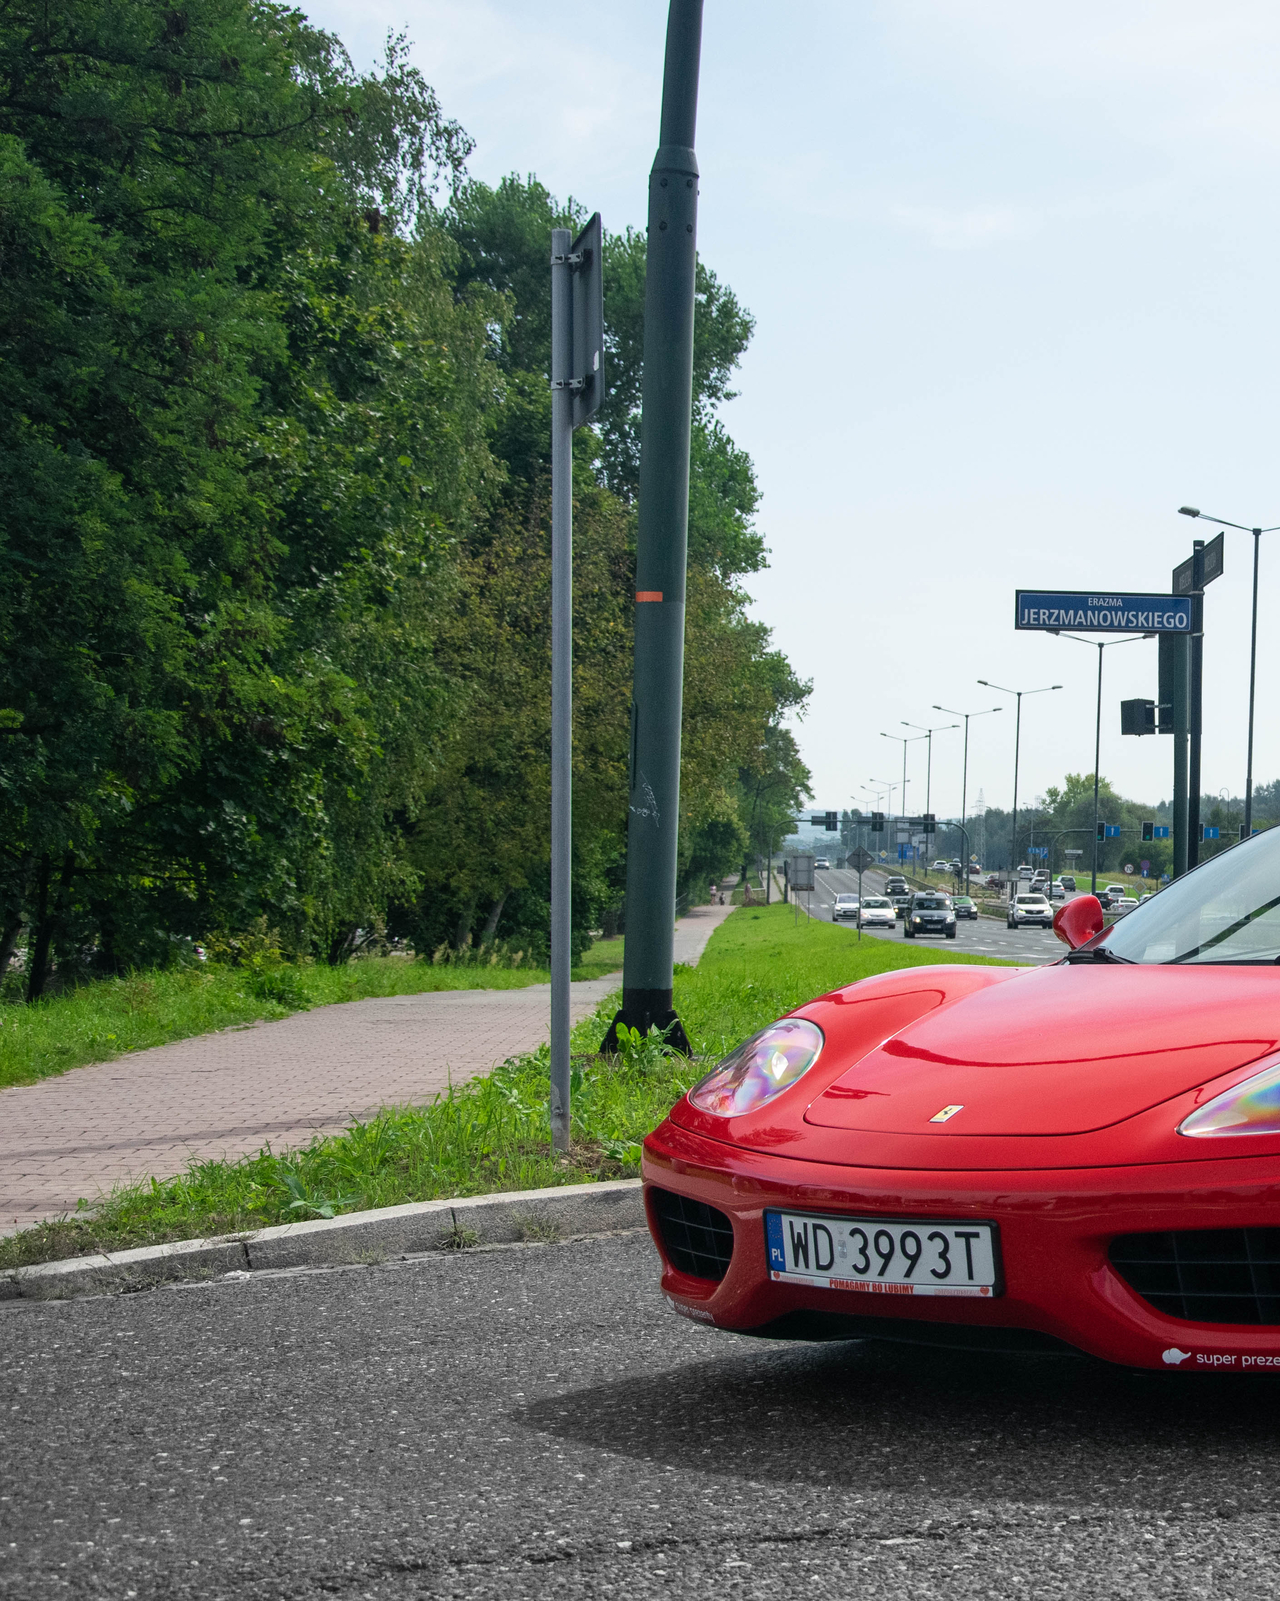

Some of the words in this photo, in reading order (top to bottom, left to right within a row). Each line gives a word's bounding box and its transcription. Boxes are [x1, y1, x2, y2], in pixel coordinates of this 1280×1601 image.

[1088, 598, 1123, 607] ERAZMA
[1022, 609, 1187, 628] JERZMANOWSKIEGO
[771, 1248, 784, 1262] PL
[789, 1220, 834, 1271] WD
[849, 1227, 980, 1281] 3993T
[829, 1278, 870, 1291] POMAGAMY
[872, 1282, 883, 1293] BO
[884, 1283, 915, 1295] LUBIMY
[1196, 1353, 1237, 1366] super
